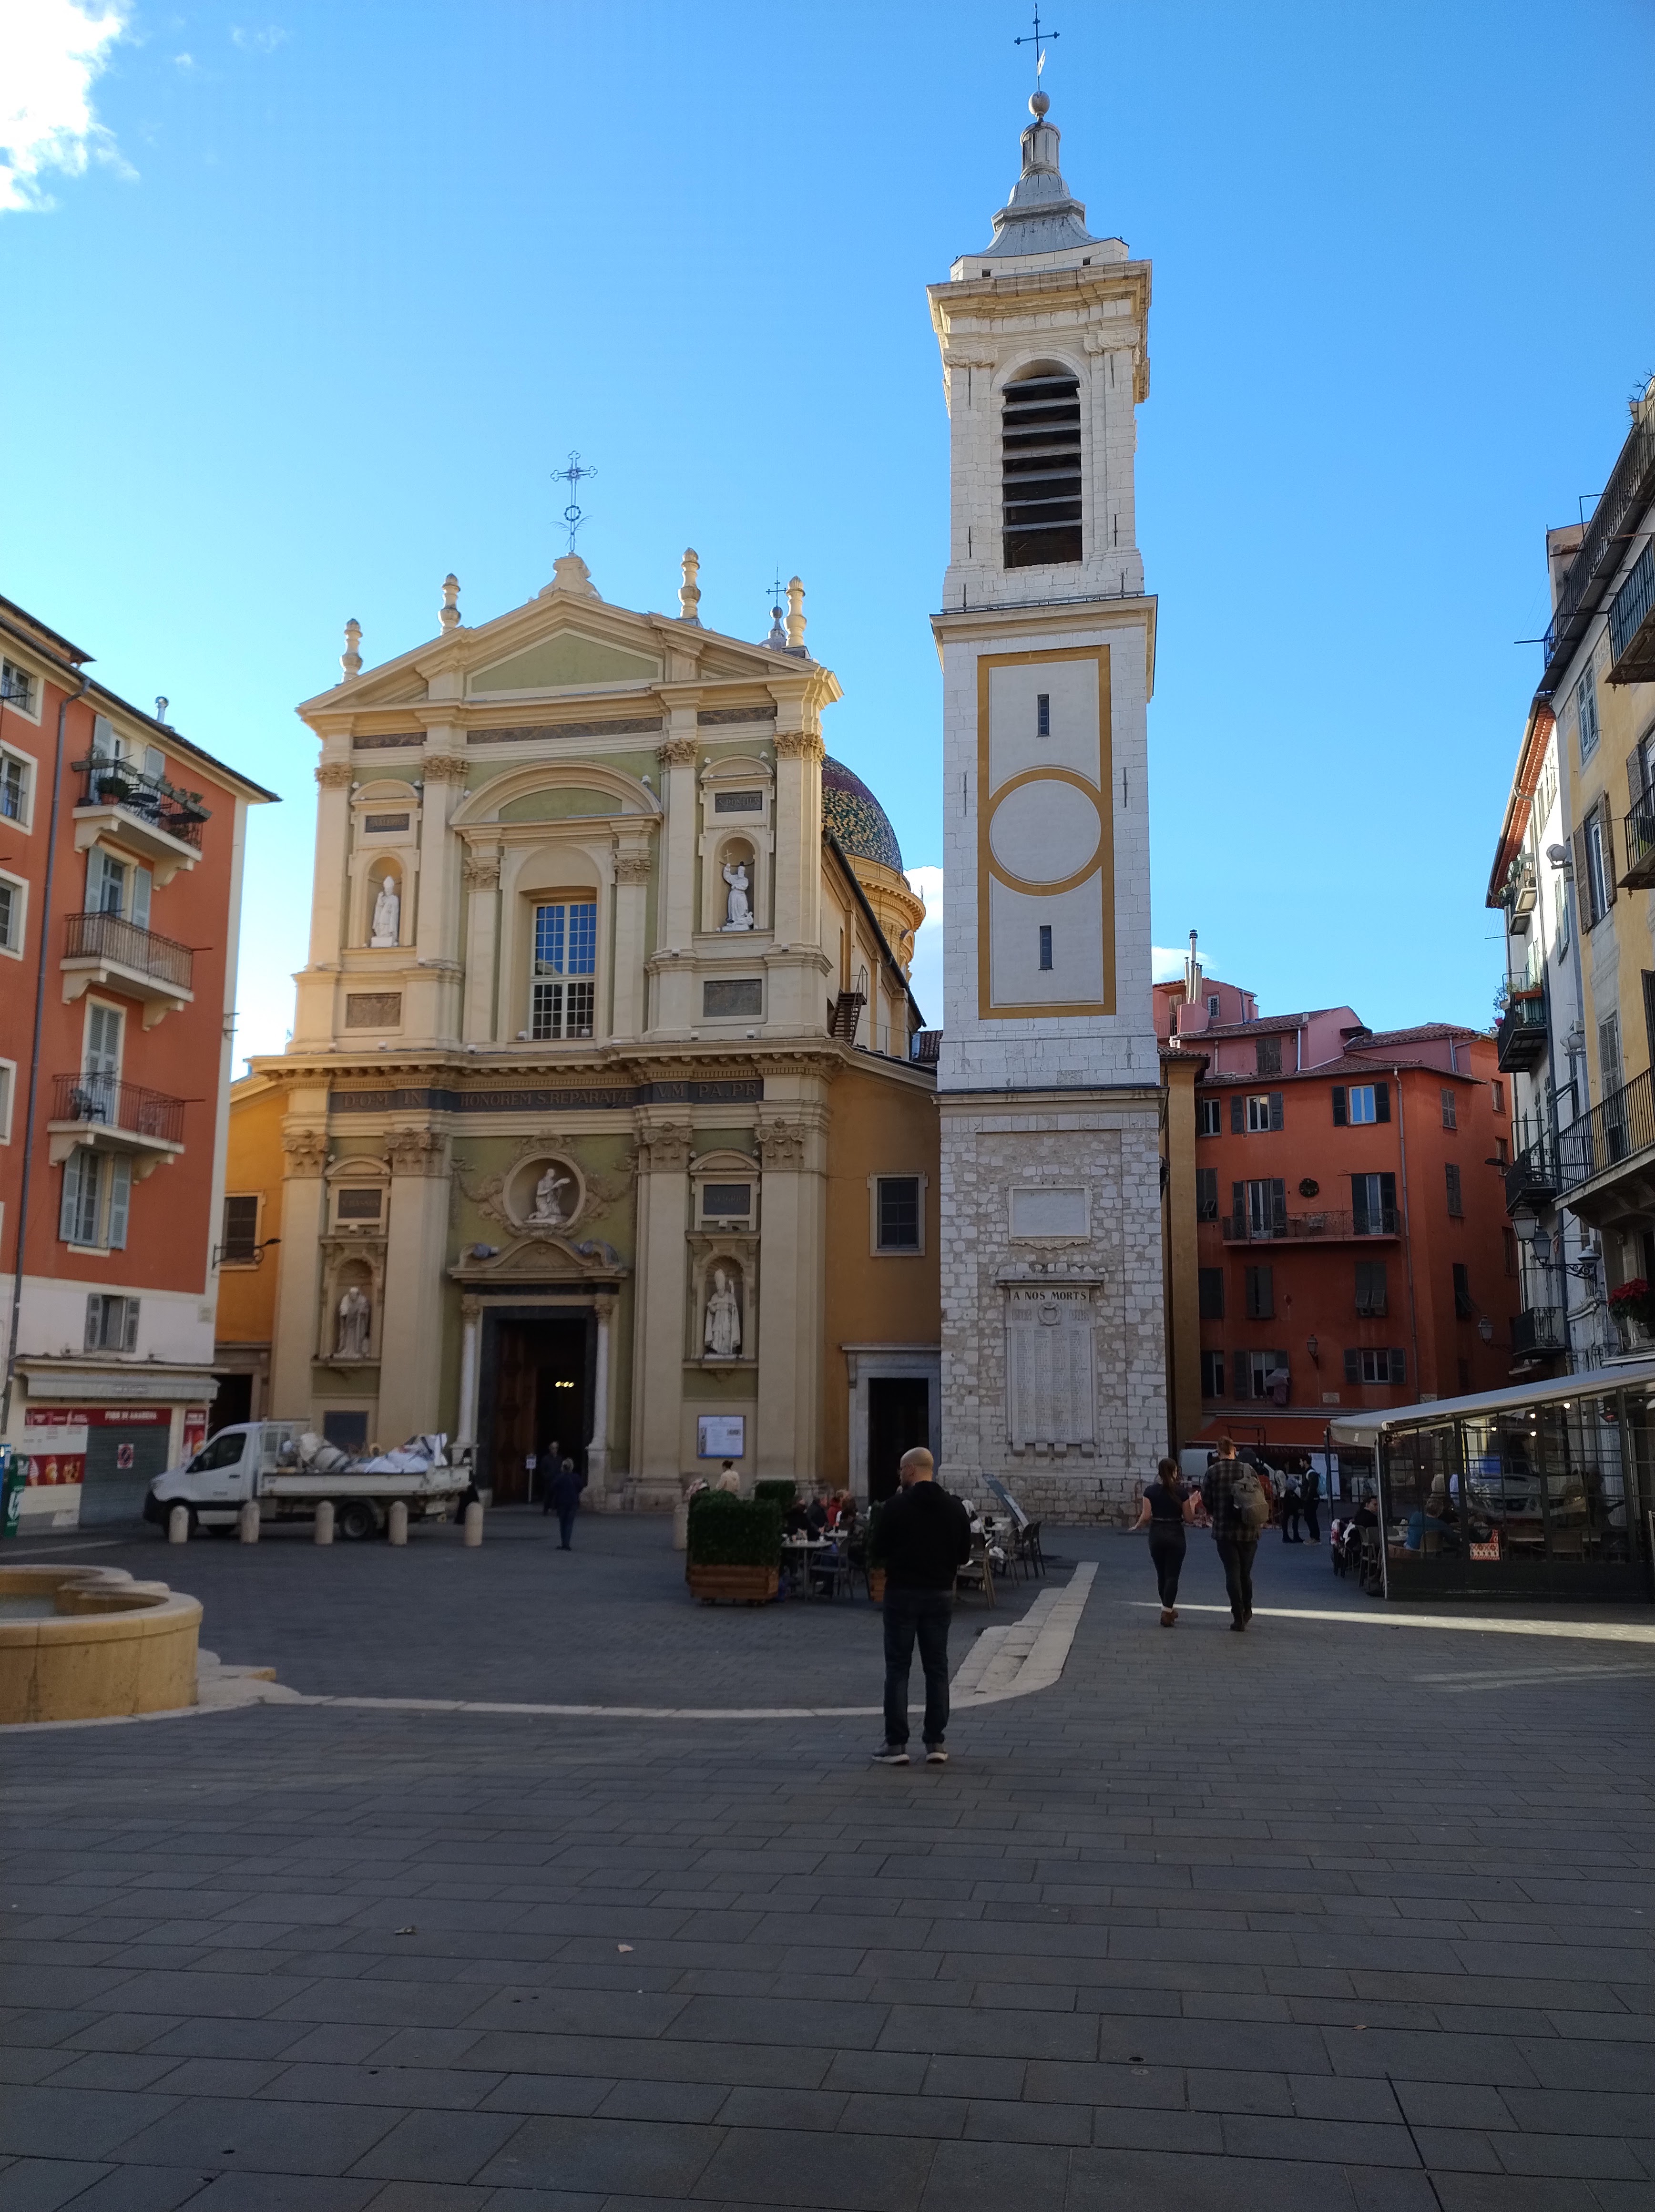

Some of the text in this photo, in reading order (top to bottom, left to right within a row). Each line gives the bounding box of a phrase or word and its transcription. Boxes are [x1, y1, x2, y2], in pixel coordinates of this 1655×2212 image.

[404, 1091, 422, 1105] IN
[460, 1093, 532, 1106] HONOREM
[1013, 1291, 1086, 1300] A NOS MORTS
